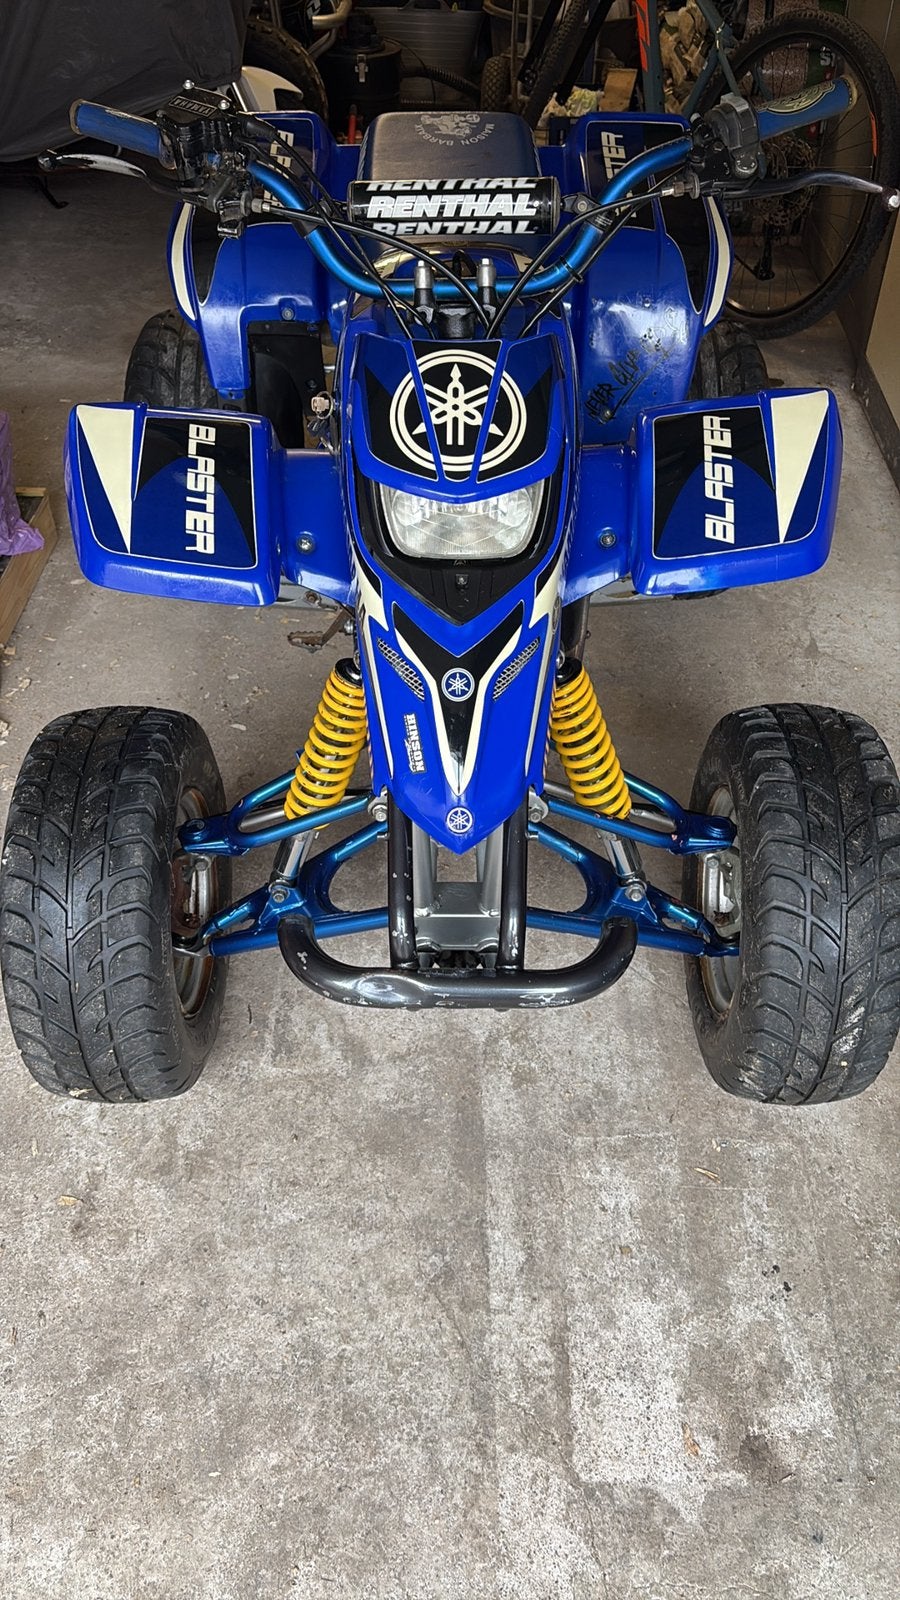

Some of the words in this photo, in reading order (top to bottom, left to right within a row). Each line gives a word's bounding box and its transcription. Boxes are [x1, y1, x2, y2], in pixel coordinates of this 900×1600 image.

[174, 99, 212, 115] YAMAHA
[461, 123, 495, 146] MAISON
[366, 193, 537, 219] RENTHAL
[185, 423, 216, 554] BLASTER
[703, 415, 735, 544] BLASTER
[406, 713, 425, 771] HINSON
